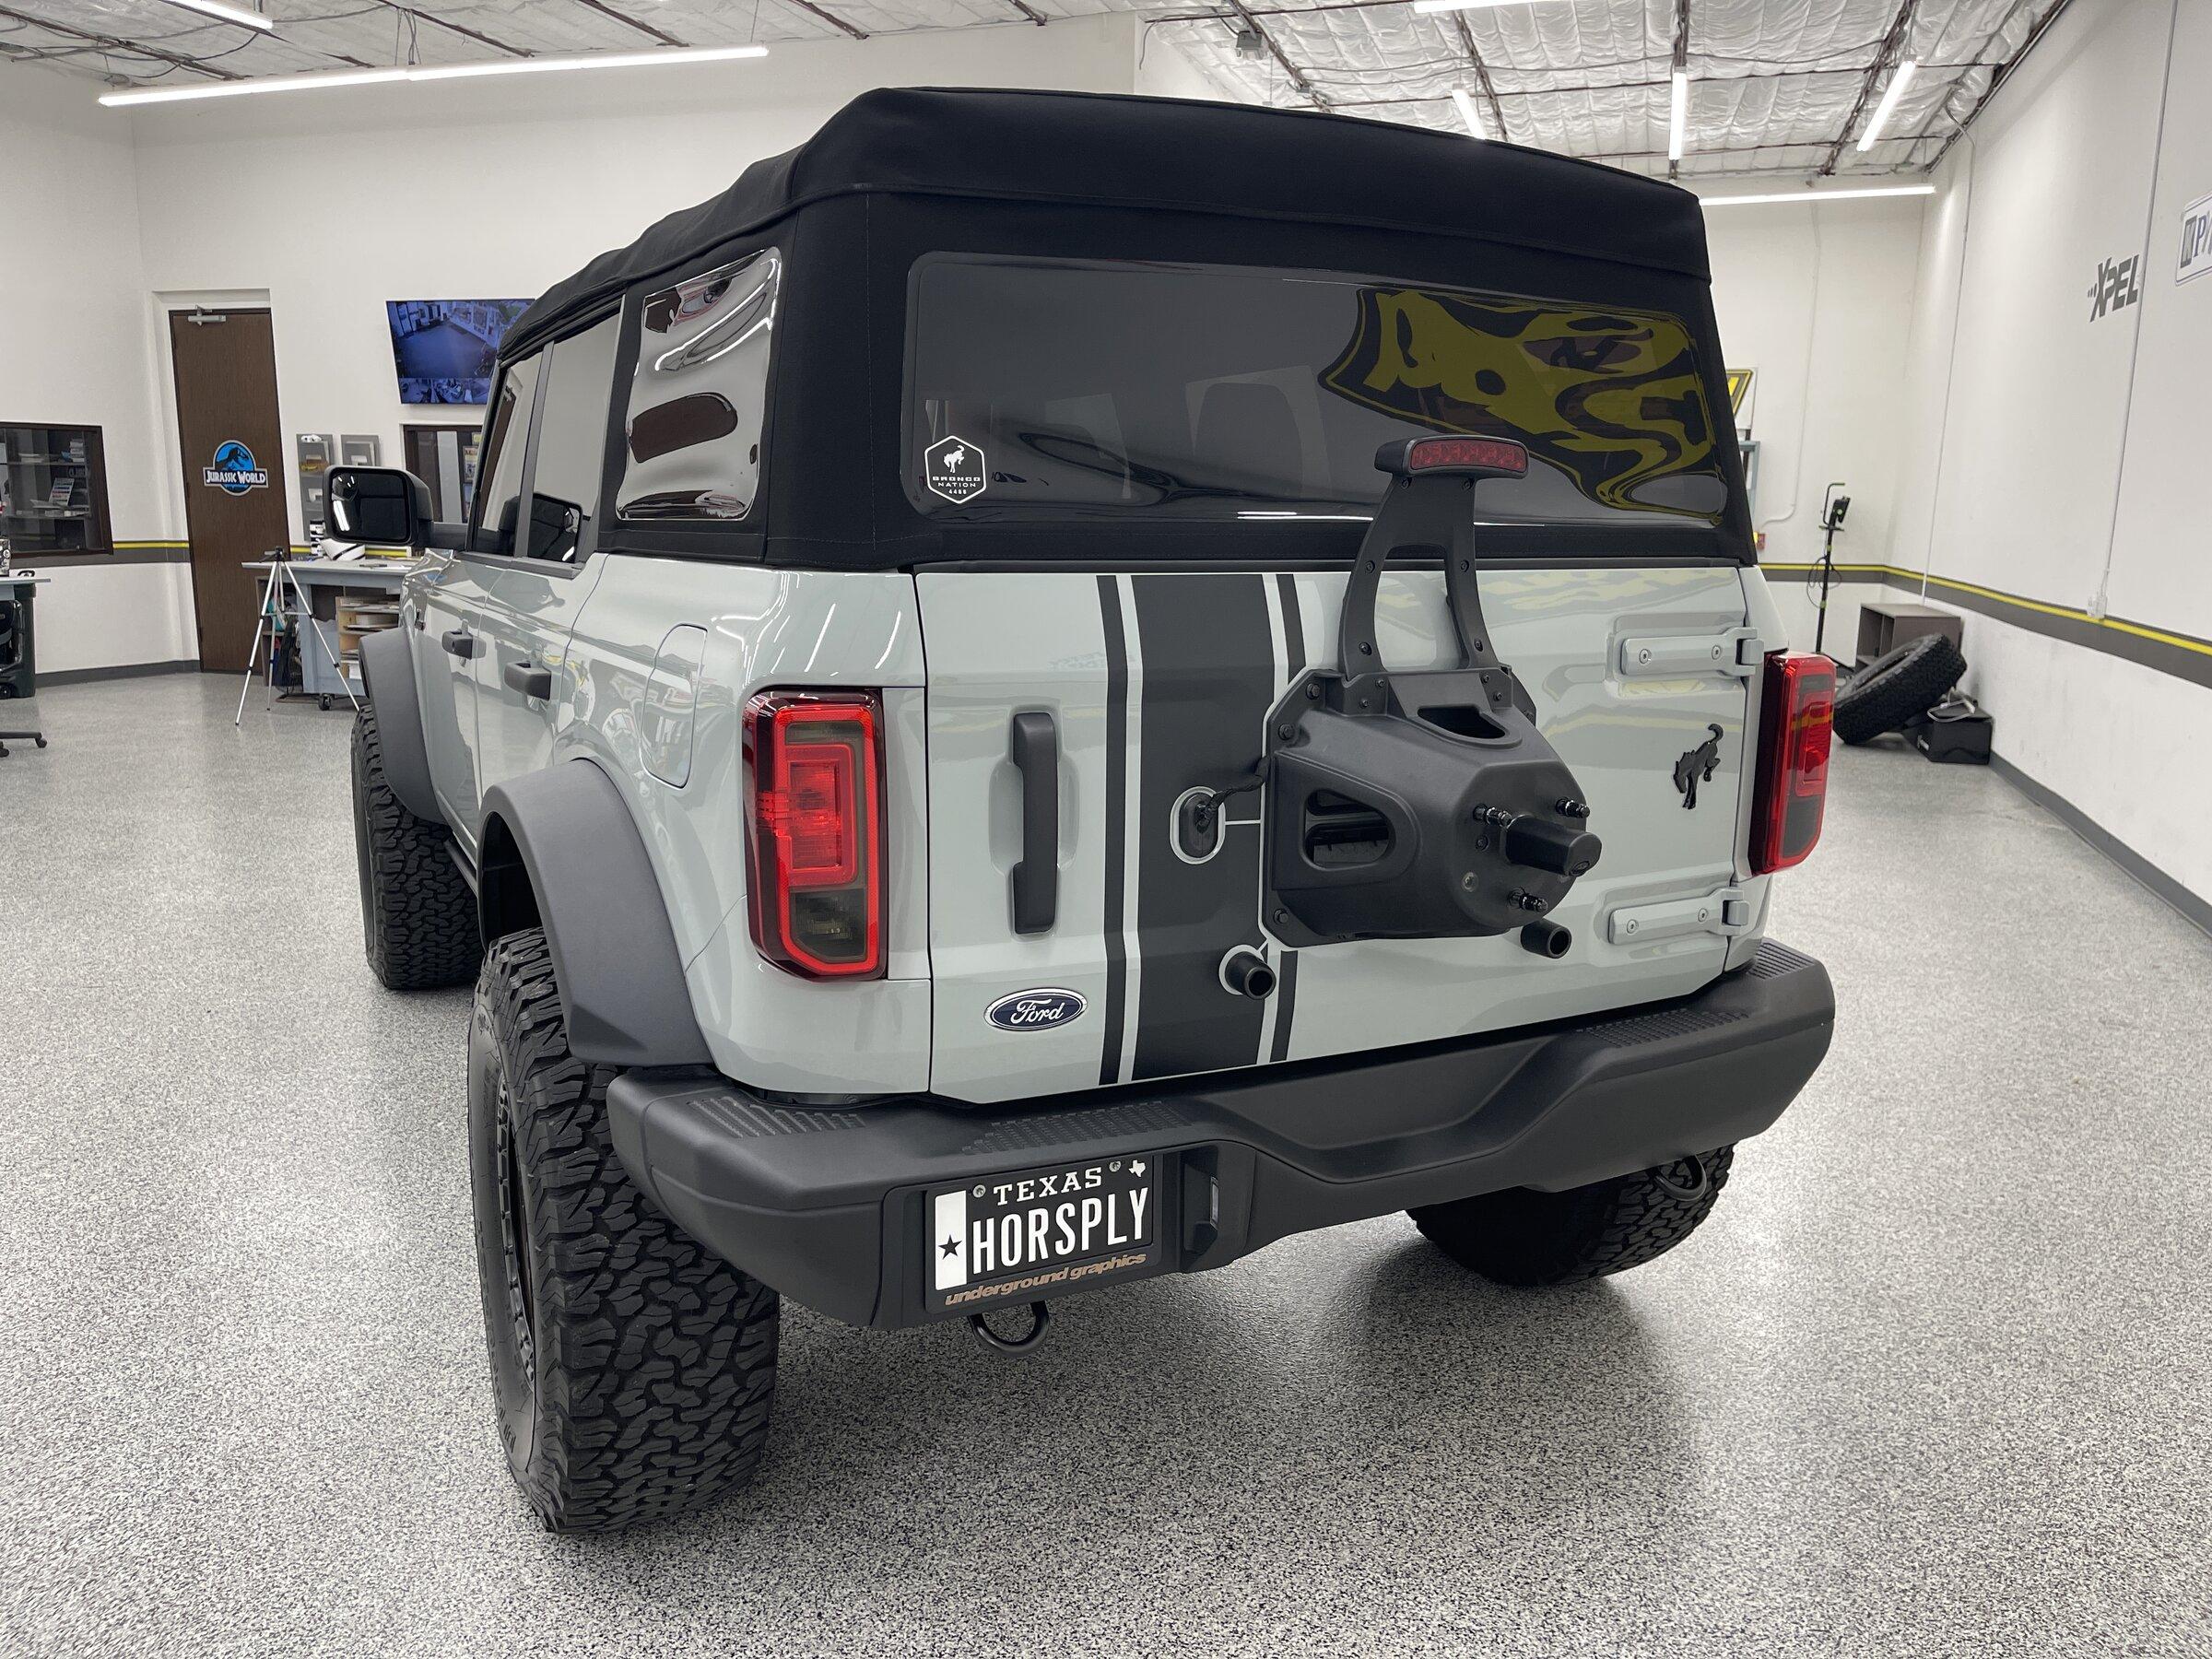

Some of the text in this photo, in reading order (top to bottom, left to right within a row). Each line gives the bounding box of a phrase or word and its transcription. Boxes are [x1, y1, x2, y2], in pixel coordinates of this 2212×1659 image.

[2089, 253, 2140, 323] XPEL
[206, 470, 265, 484] JURASSIC WORLD
[1010, 998, 1065, 1024] Ford
[993, 1167, 1102, 1206] TEXAS
[972, 1187, 1148, 1275] HORSPLY
[945, 1253, 1147, 1306] underground graphics
